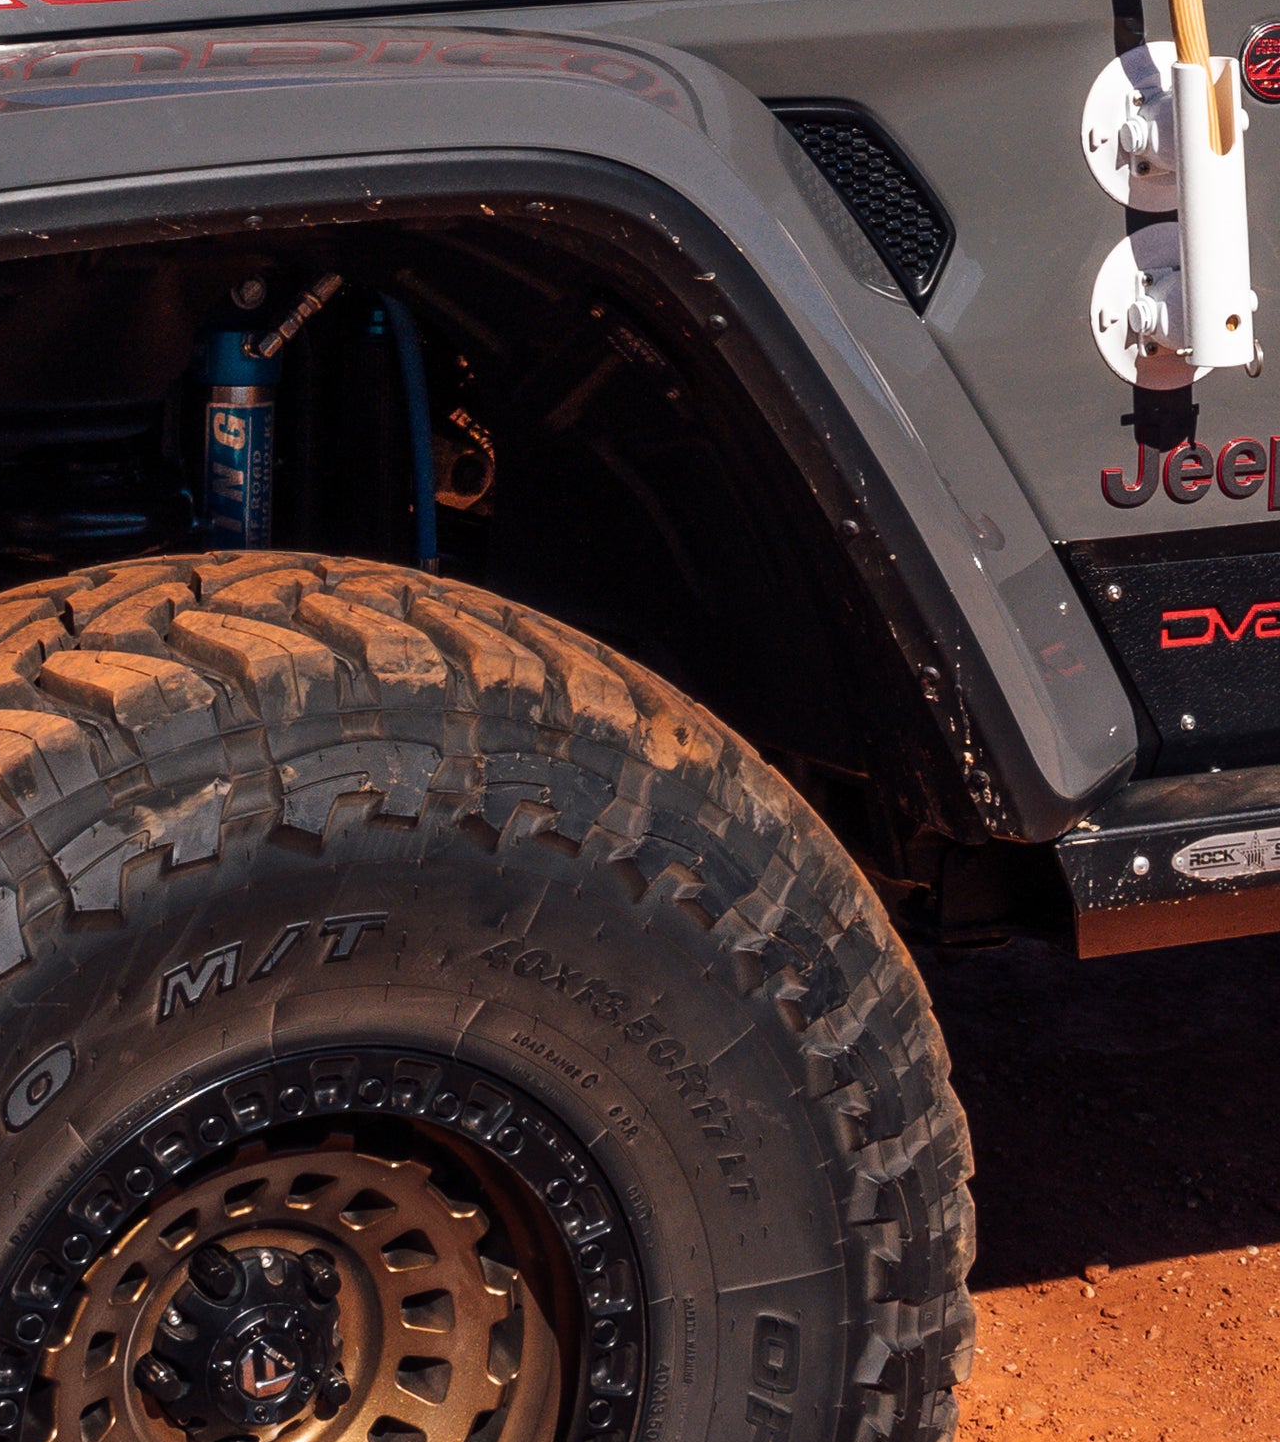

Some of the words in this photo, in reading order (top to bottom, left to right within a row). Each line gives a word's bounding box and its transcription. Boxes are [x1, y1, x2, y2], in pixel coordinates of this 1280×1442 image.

[1189, 848, 1236, 867] ROCK
[155, 910, 390, 1025] M/T
[510, 1031, 547, 1056] LOAD
[579, 1073, 600, 1091] C
